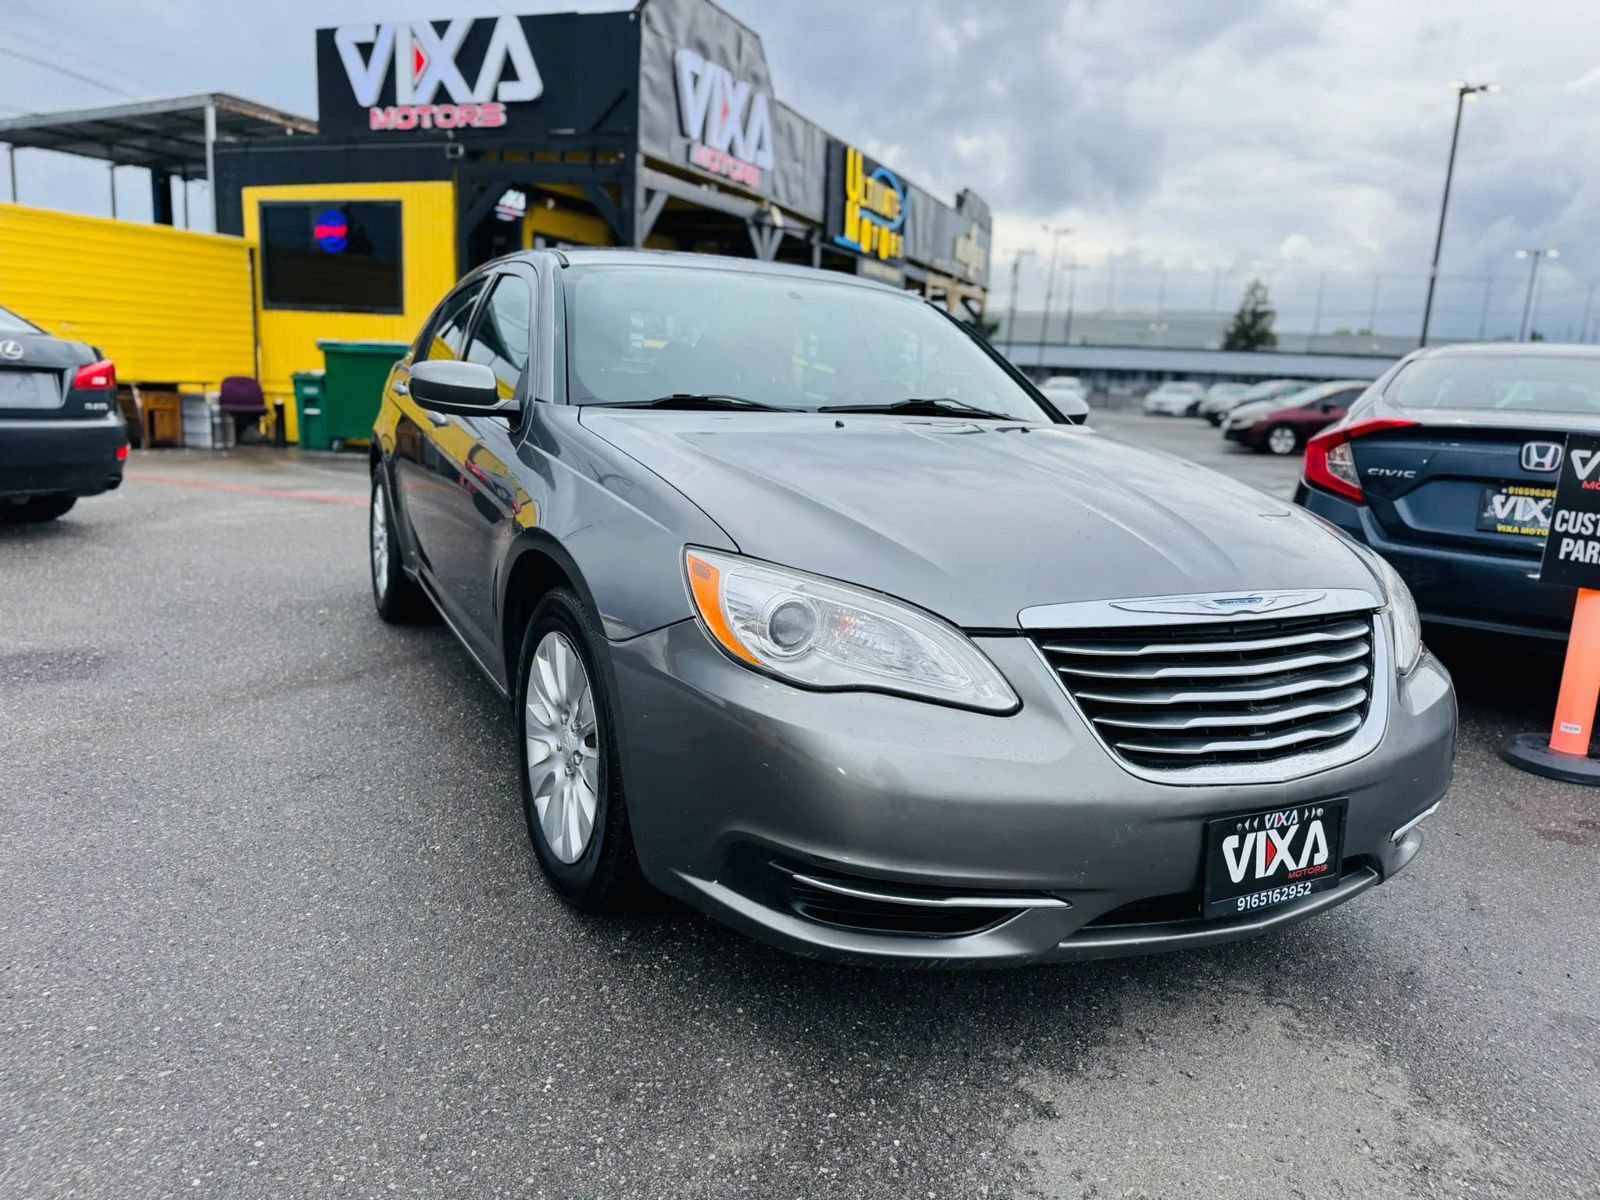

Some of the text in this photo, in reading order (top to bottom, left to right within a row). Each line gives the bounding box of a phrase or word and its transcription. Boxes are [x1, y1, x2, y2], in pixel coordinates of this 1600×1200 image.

[334, 15, 543, 107] VIXA
[369, 101, 507, 131] MOTORS
[674, 48, 774, 171] VIXA
[1367, 467, 1417, 479] CIVIC
[1570, 449, 1600, 480] V
[1492, 494, 1552, 524] VIX
[1496, 523, 1549, 537] VIXA MOTO
[1558, 537, 1600, 564] PAR
[1264, 809, 1298, 829] VIXA
[1222, 819, 1329, 884] VIXA
[1287, 864, 1328, 880] MOTORS
[1237, 881, 1312, 912] 9165162952
